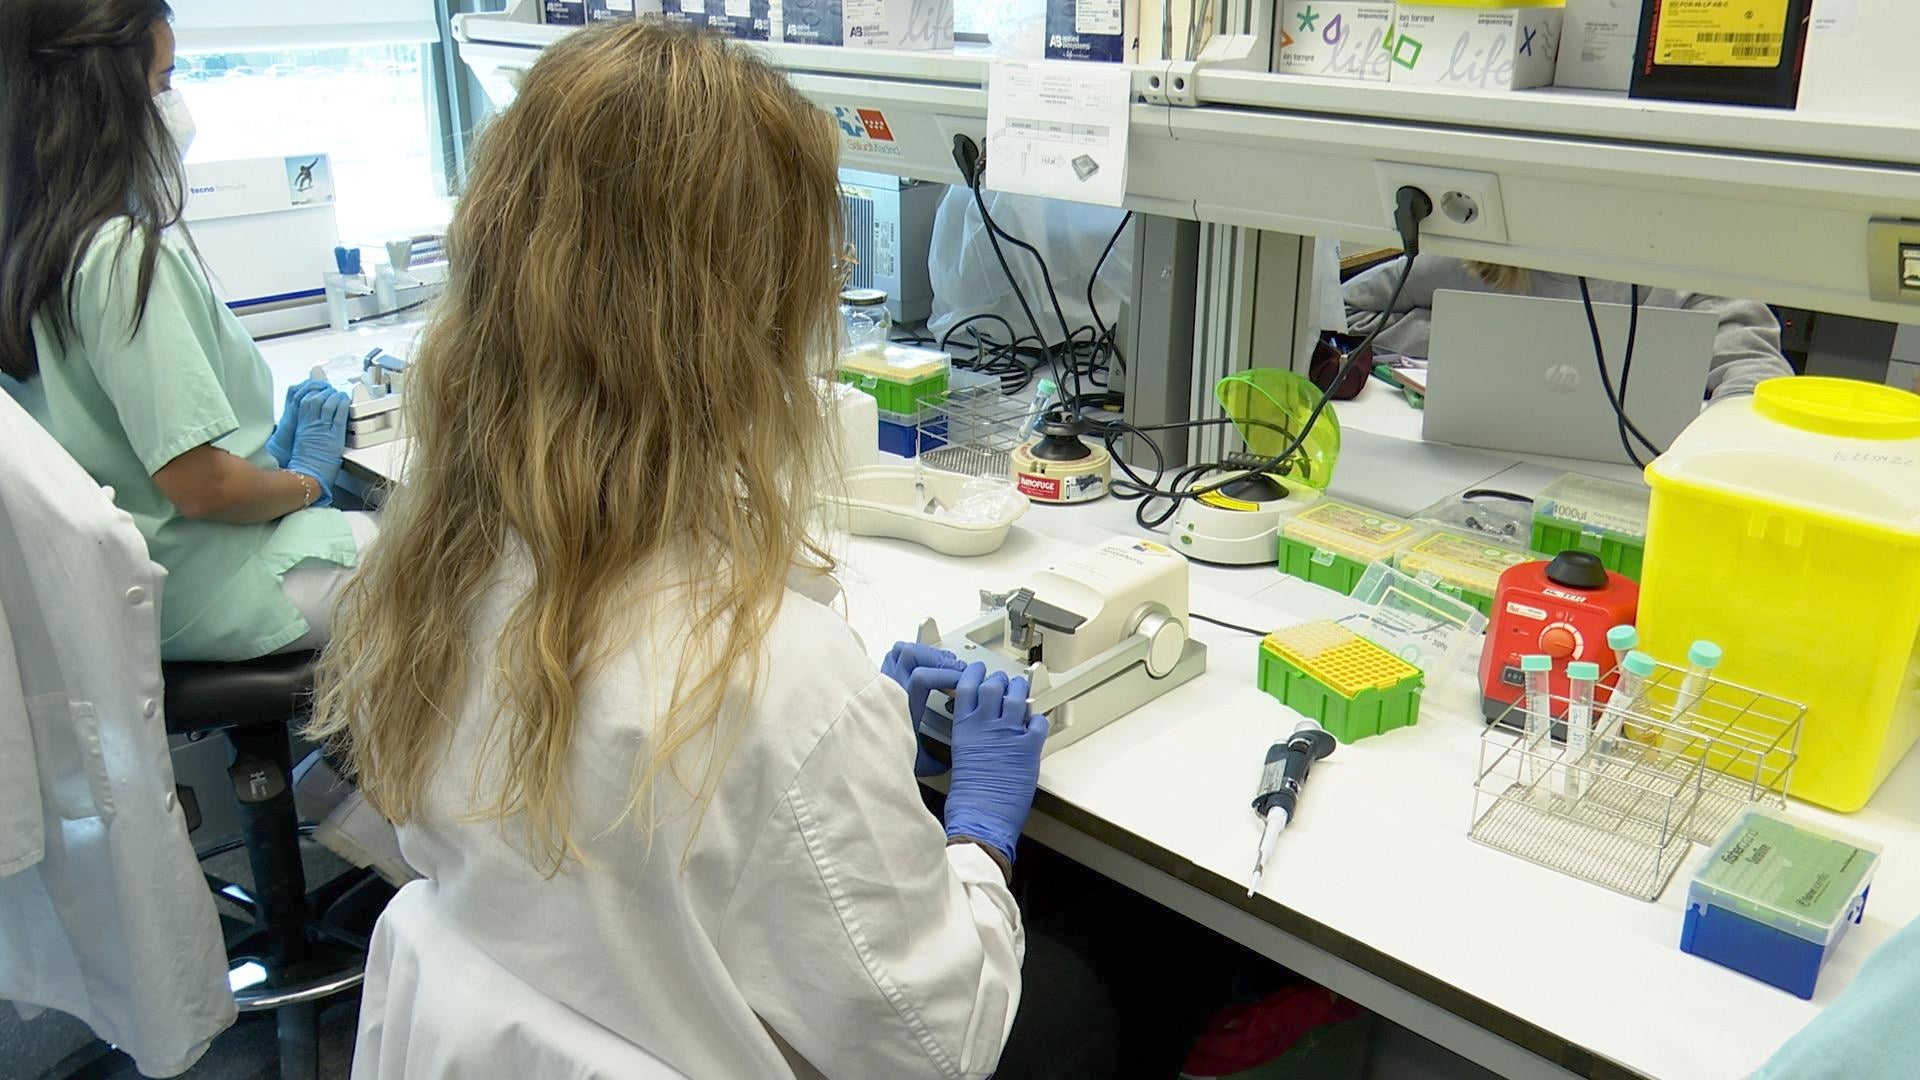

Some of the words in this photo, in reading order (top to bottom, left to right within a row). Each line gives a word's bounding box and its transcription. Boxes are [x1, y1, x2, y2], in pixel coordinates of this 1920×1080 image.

[1410, 14, 1435, 23] torrent
[850, 27, 863, 38] AB
[1049, 34, 1063, 48] AB
[1438, 31, 1514, 89] life
